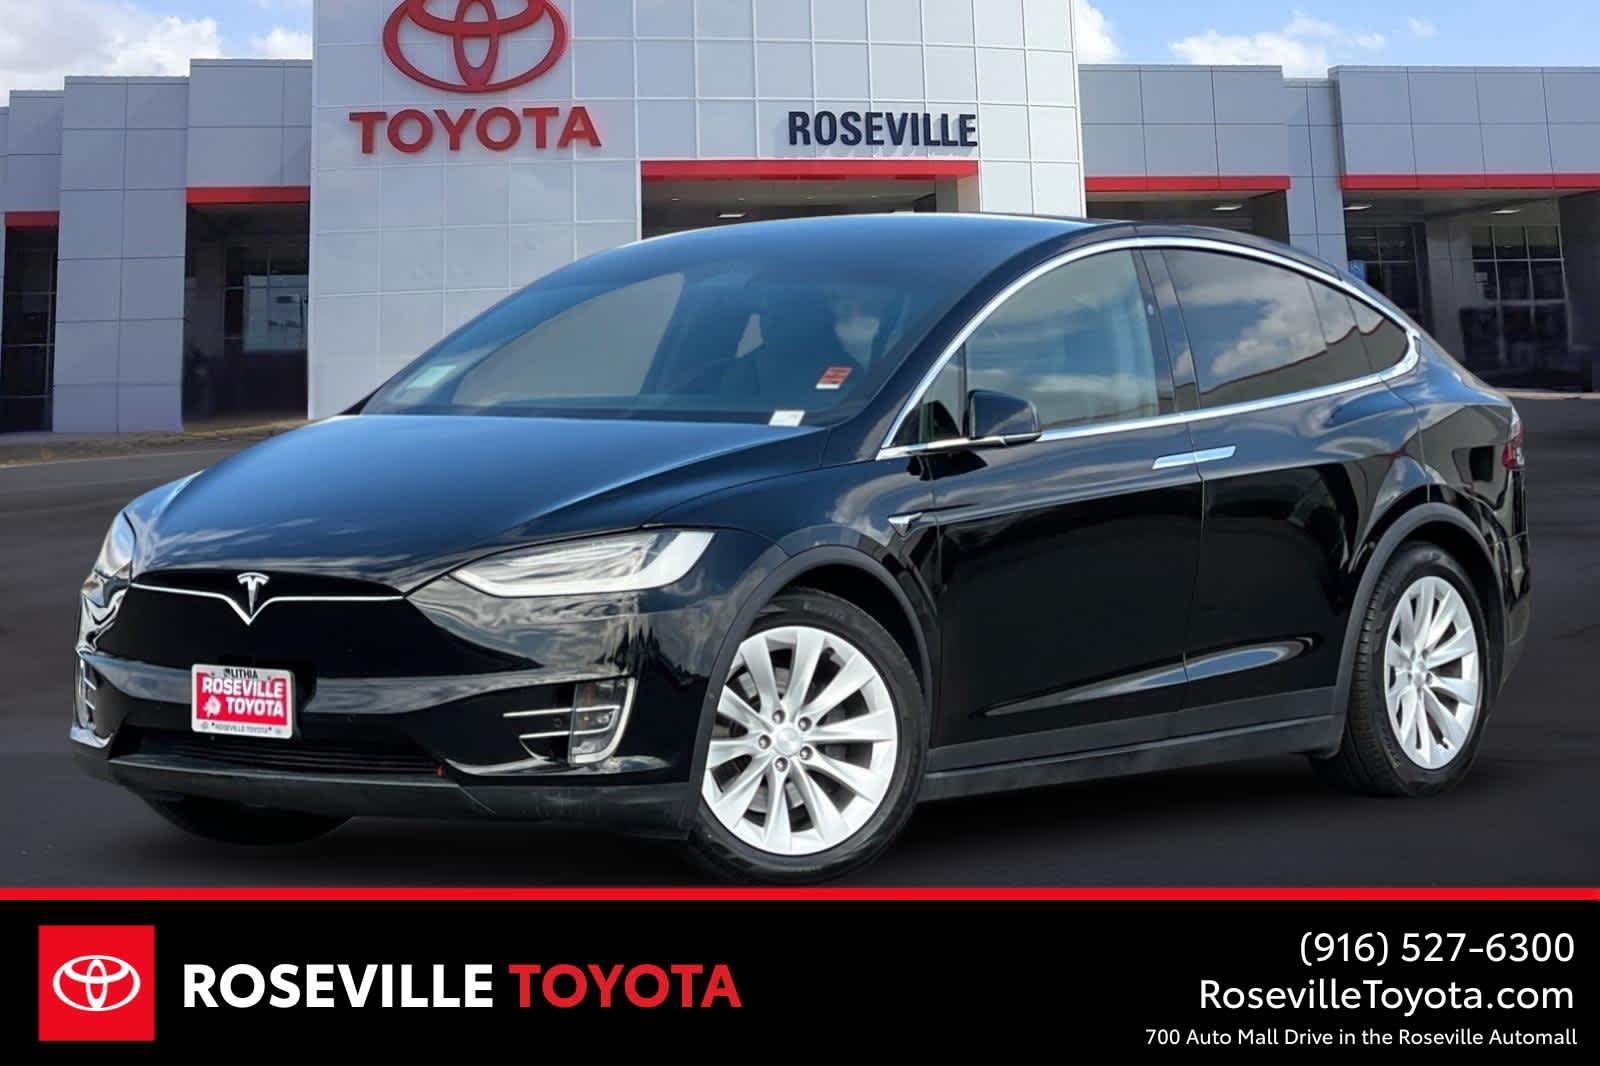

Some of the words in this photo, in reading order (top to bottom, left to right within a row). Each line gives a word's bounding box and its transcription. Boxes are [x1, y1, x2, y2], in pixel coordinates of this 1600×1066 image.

[350, 106, 601, 154] TOYOTA
[788, 111, 978, 149] ROSEVILLE
[230, 669, 258, 679] LITHIA
[201, 677, 285, 698] ROSEVILLE
[227, 698, 285, 717] TOYOTA
